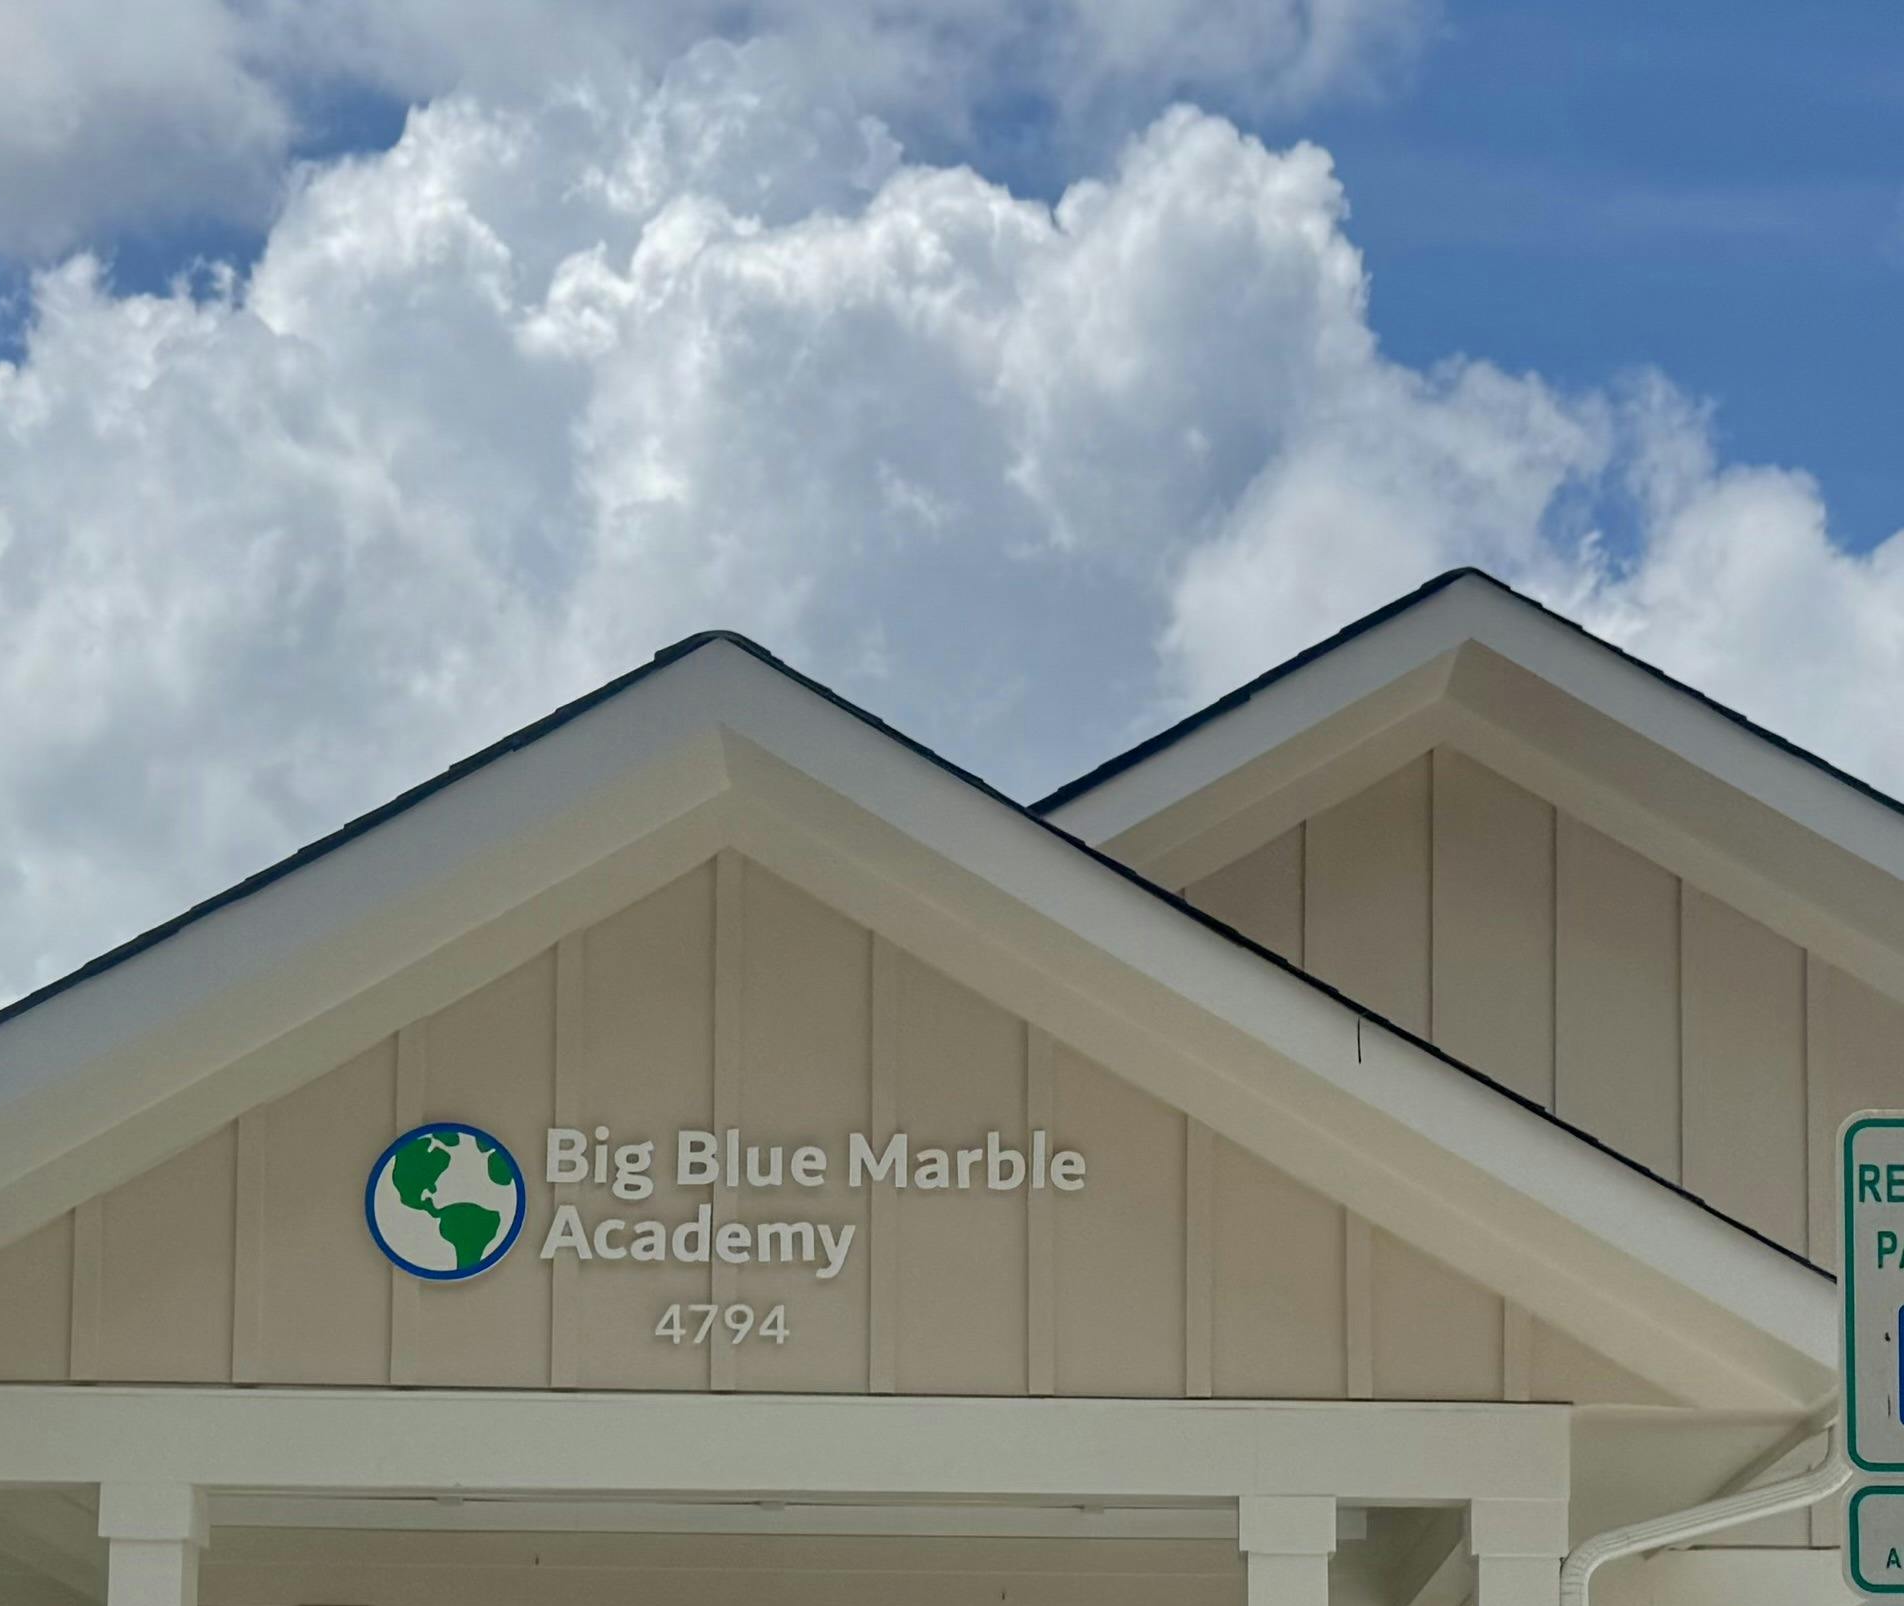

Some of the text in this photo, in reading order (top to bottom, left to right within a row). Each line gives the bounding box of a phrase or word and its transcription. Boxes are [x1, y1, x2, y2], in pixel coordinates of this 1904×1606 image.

[546, 1125, 1087, 1200] Big Blue Marble
[540, 1203, 856, 1279] Academy
[654, 1303, 790, 1345] 4794
